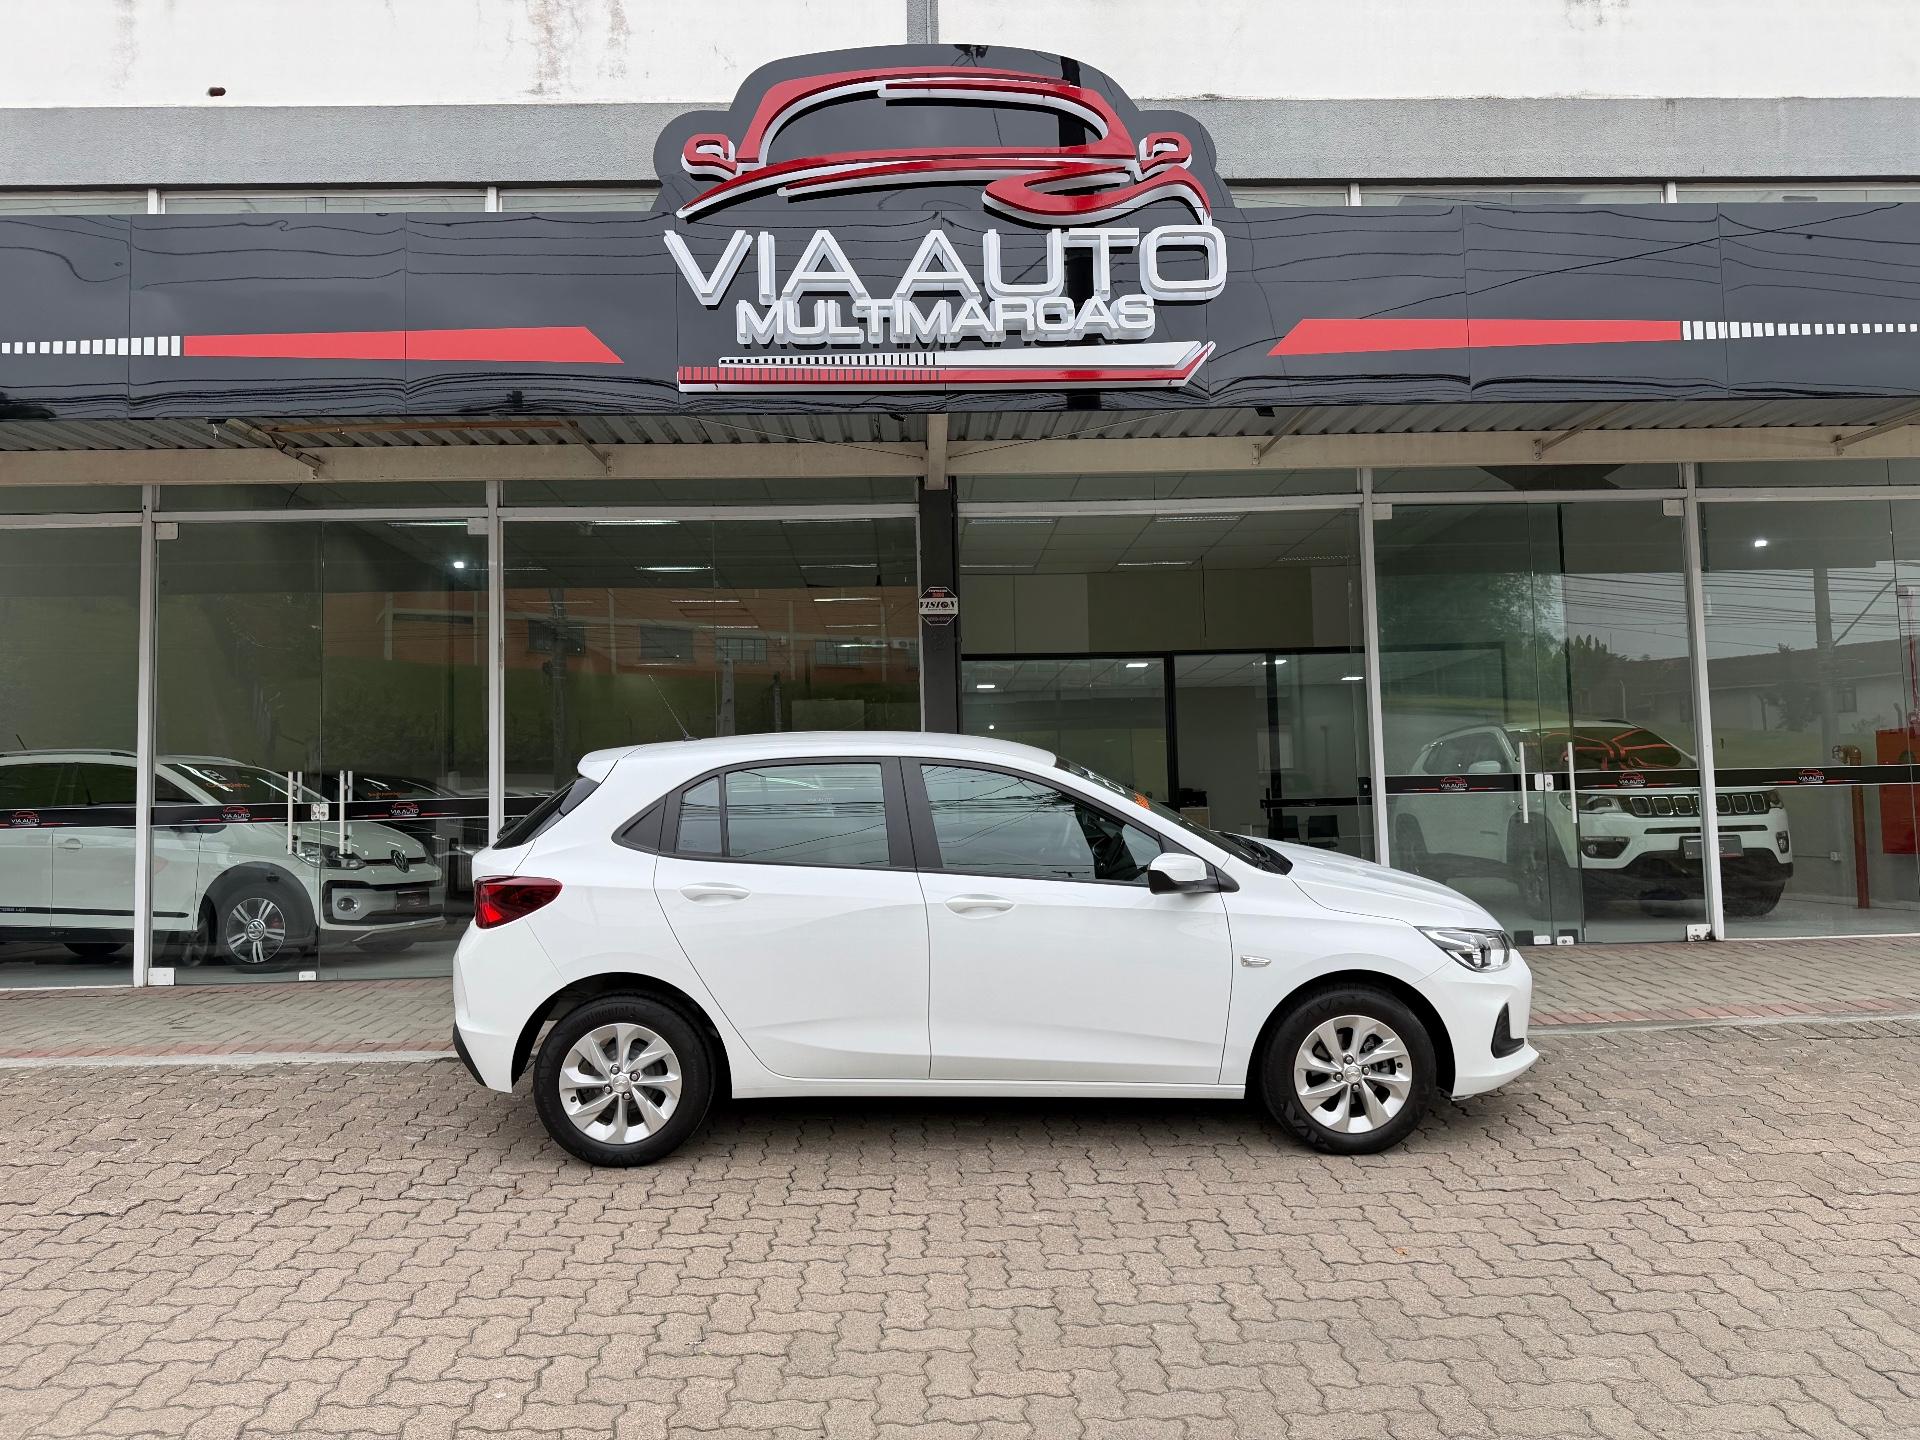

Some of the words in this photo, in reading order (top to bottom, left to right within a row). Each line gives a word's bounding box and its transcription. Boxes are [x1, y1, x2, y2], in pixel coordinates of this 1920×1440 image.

[663, 229, 871, 306] VIA
[891, 225, 1228, 302] AUTO
[735, 294, 1156, 345] MULTIMARCAS
